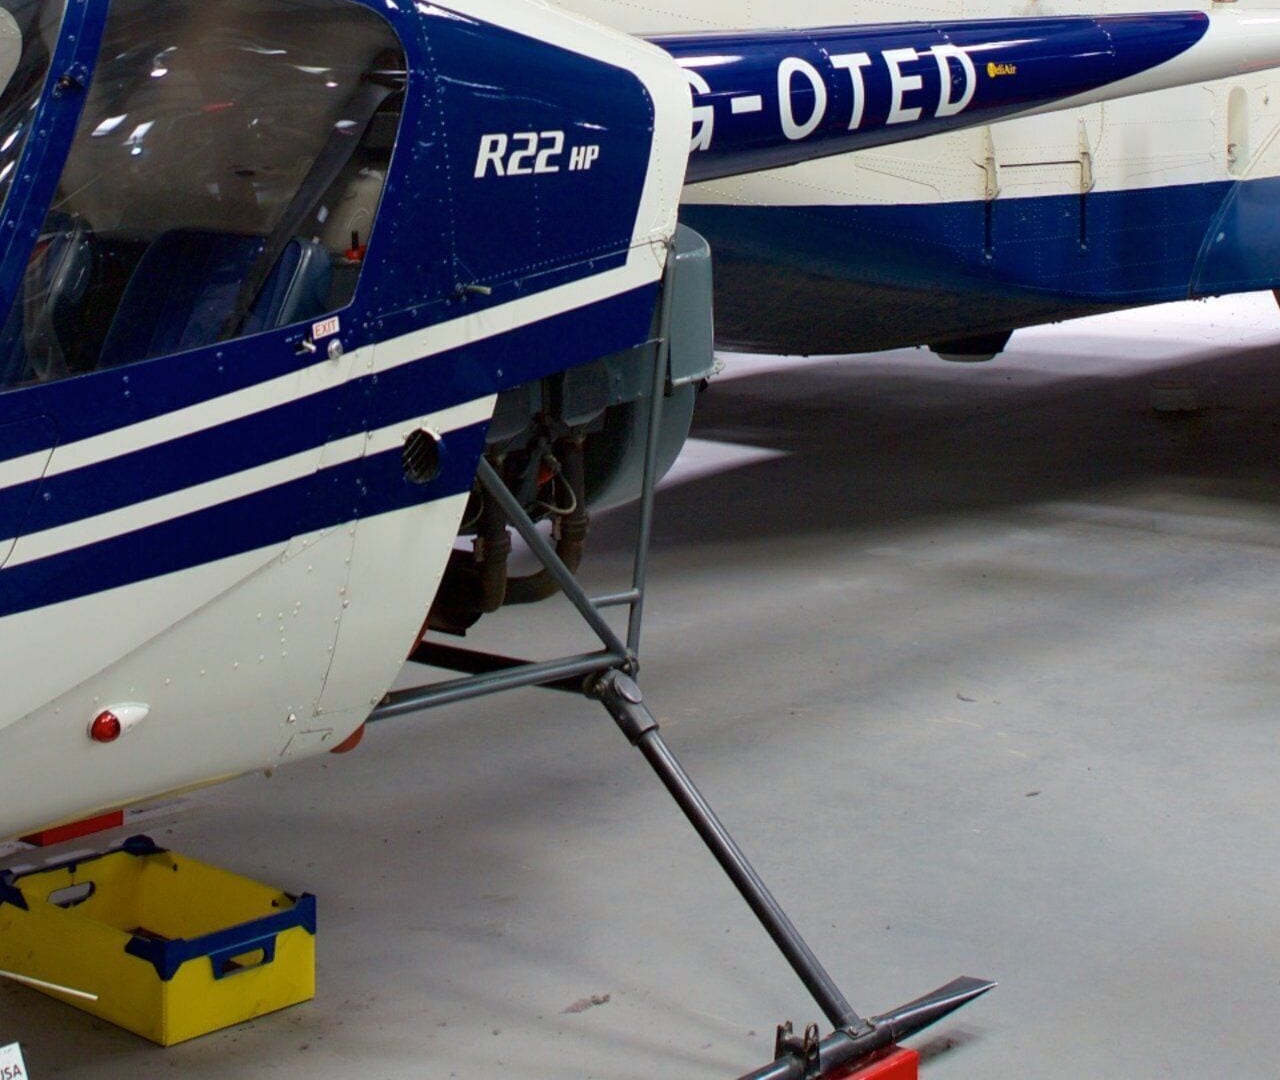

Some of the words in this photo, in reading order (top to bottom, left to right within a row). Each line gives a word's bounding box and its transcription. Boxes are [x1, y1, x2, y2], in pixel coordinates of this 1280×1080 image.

[679, 45, 977, 152] G-OTED
[473, 130, 565, 178] R22
[568, 145, 600, 171] HP
[315, 319, 337, 336] EXIT
